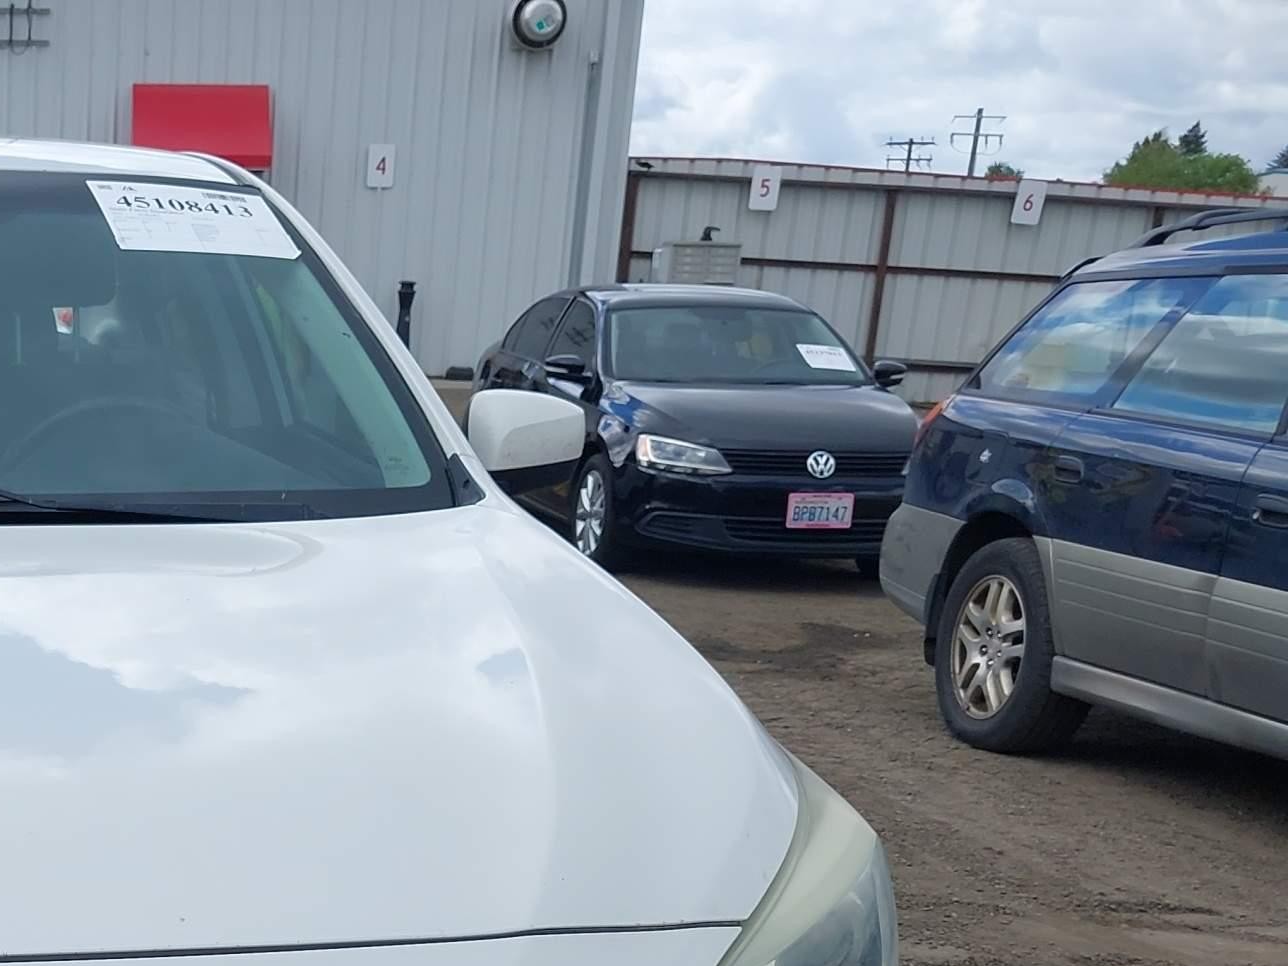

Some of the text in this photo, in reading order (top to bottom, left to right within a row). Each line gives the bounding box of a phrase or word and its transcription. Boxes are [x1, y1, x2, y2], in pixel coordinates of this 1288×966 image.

[375, 156, 386, 175] 4
[759, 178, 771, 198] 5
[116, 195, 254, 218] 45108413
[1023, 193, 1034, 211] 6
